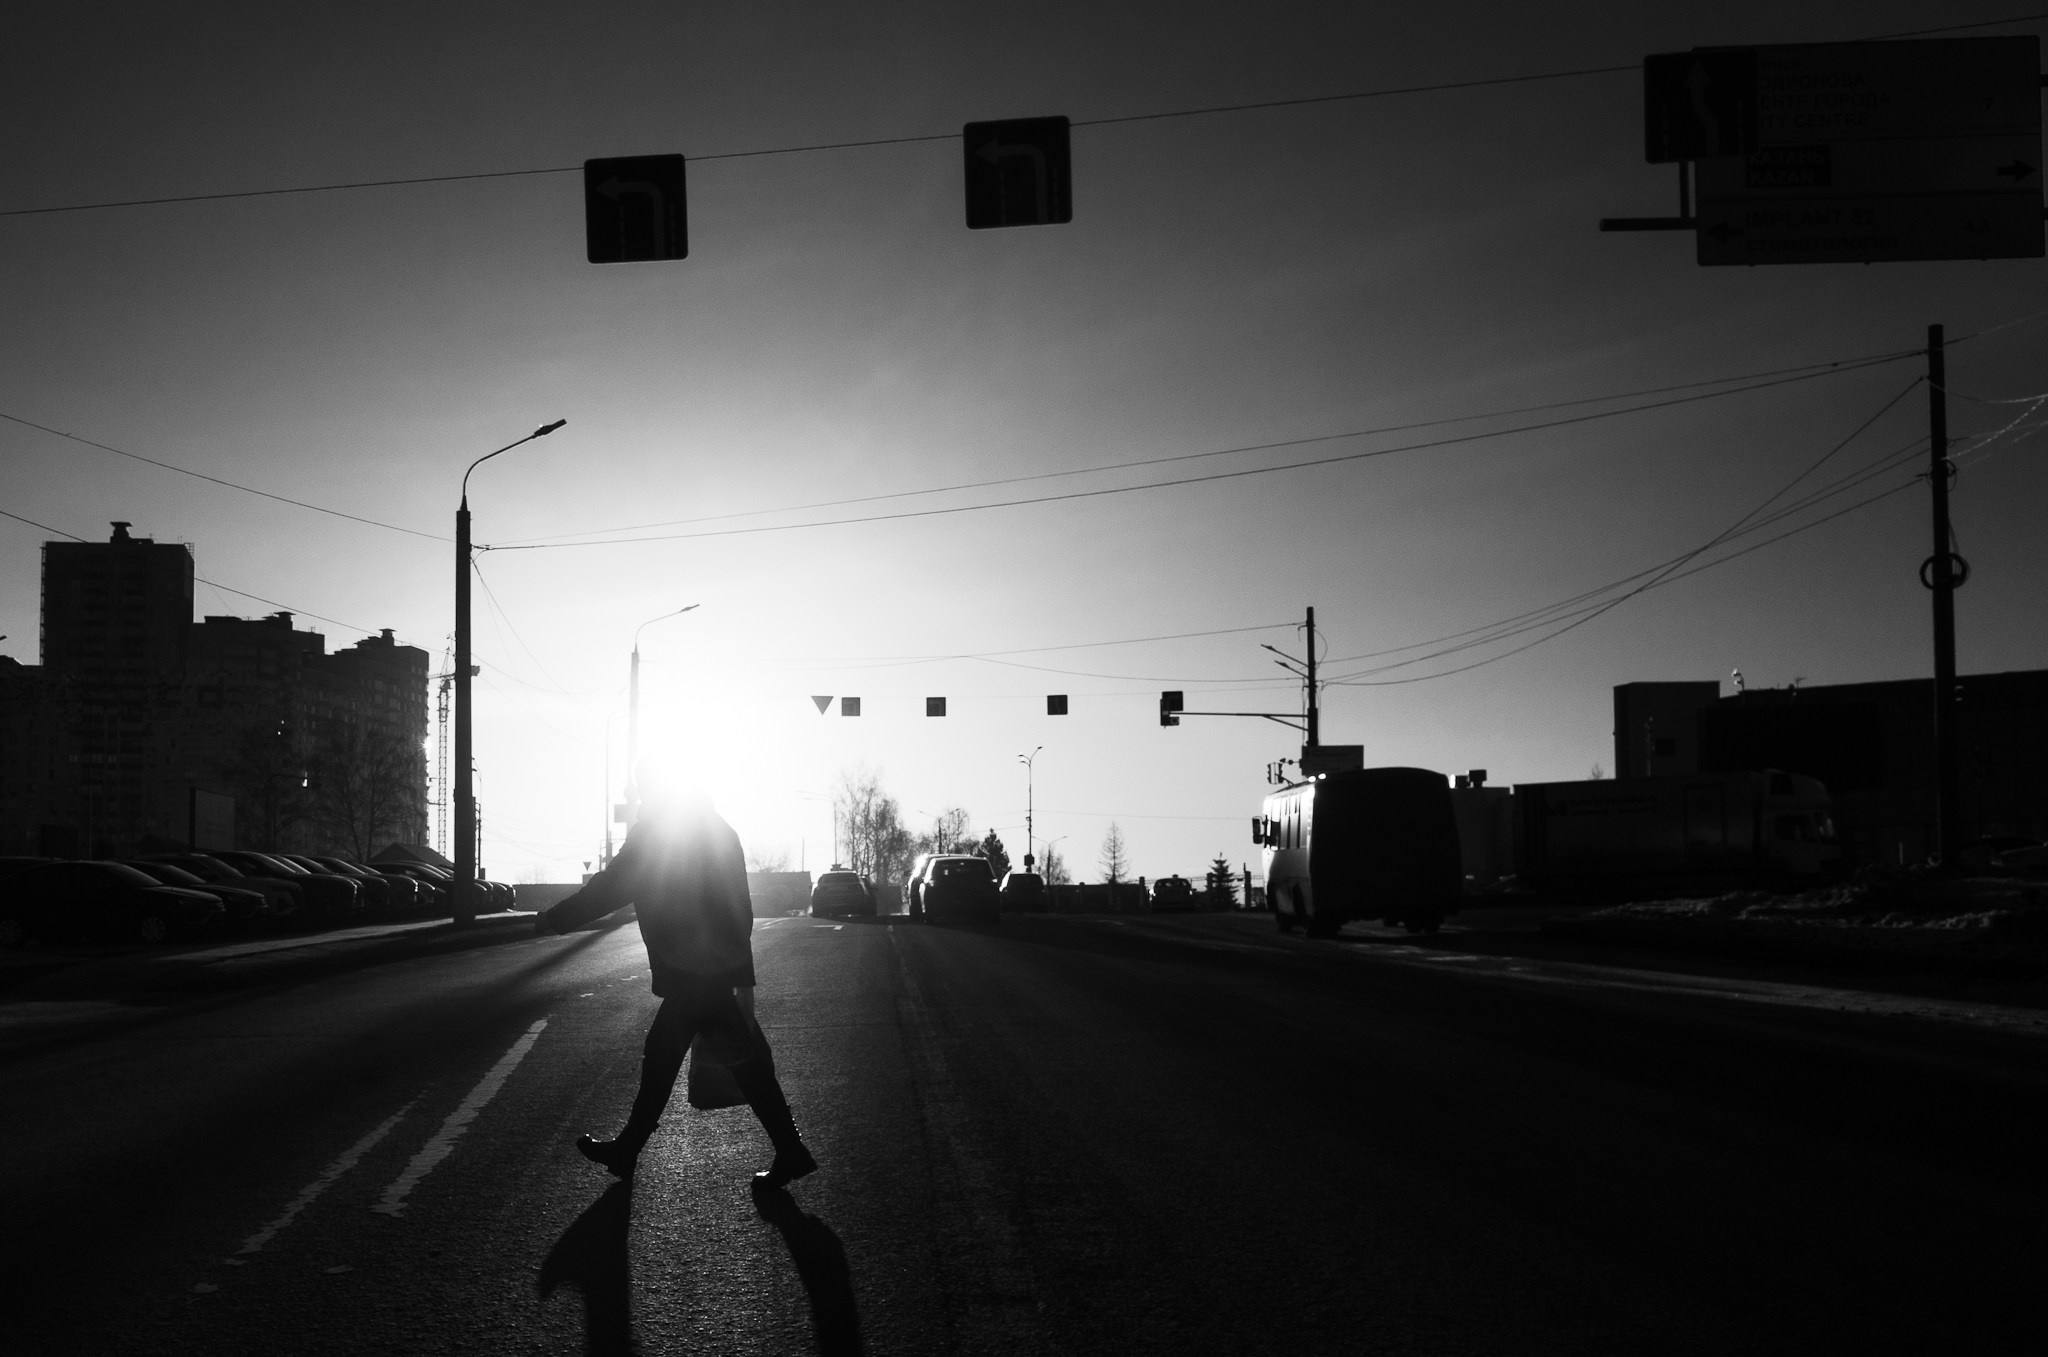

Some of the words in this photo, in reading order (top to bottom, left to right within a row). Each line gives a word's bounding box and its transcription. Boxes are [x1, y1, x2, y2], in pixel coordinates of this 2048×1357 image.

[1814, 91, 1892, 108] ГОРОДА
[1983, 97, 1993, 110] 7
[1793, 112, 1869, 128] CENTRE
[1748, 150, 1825, 166] КАЗАНЬ
[1748, 169, 1814, 185] KAZAN
[1745, 209, 1844, 228] IMPLANT
[1850, 208, 1875, 226] 52
[1746, 236, 1899, 251] стоматология
